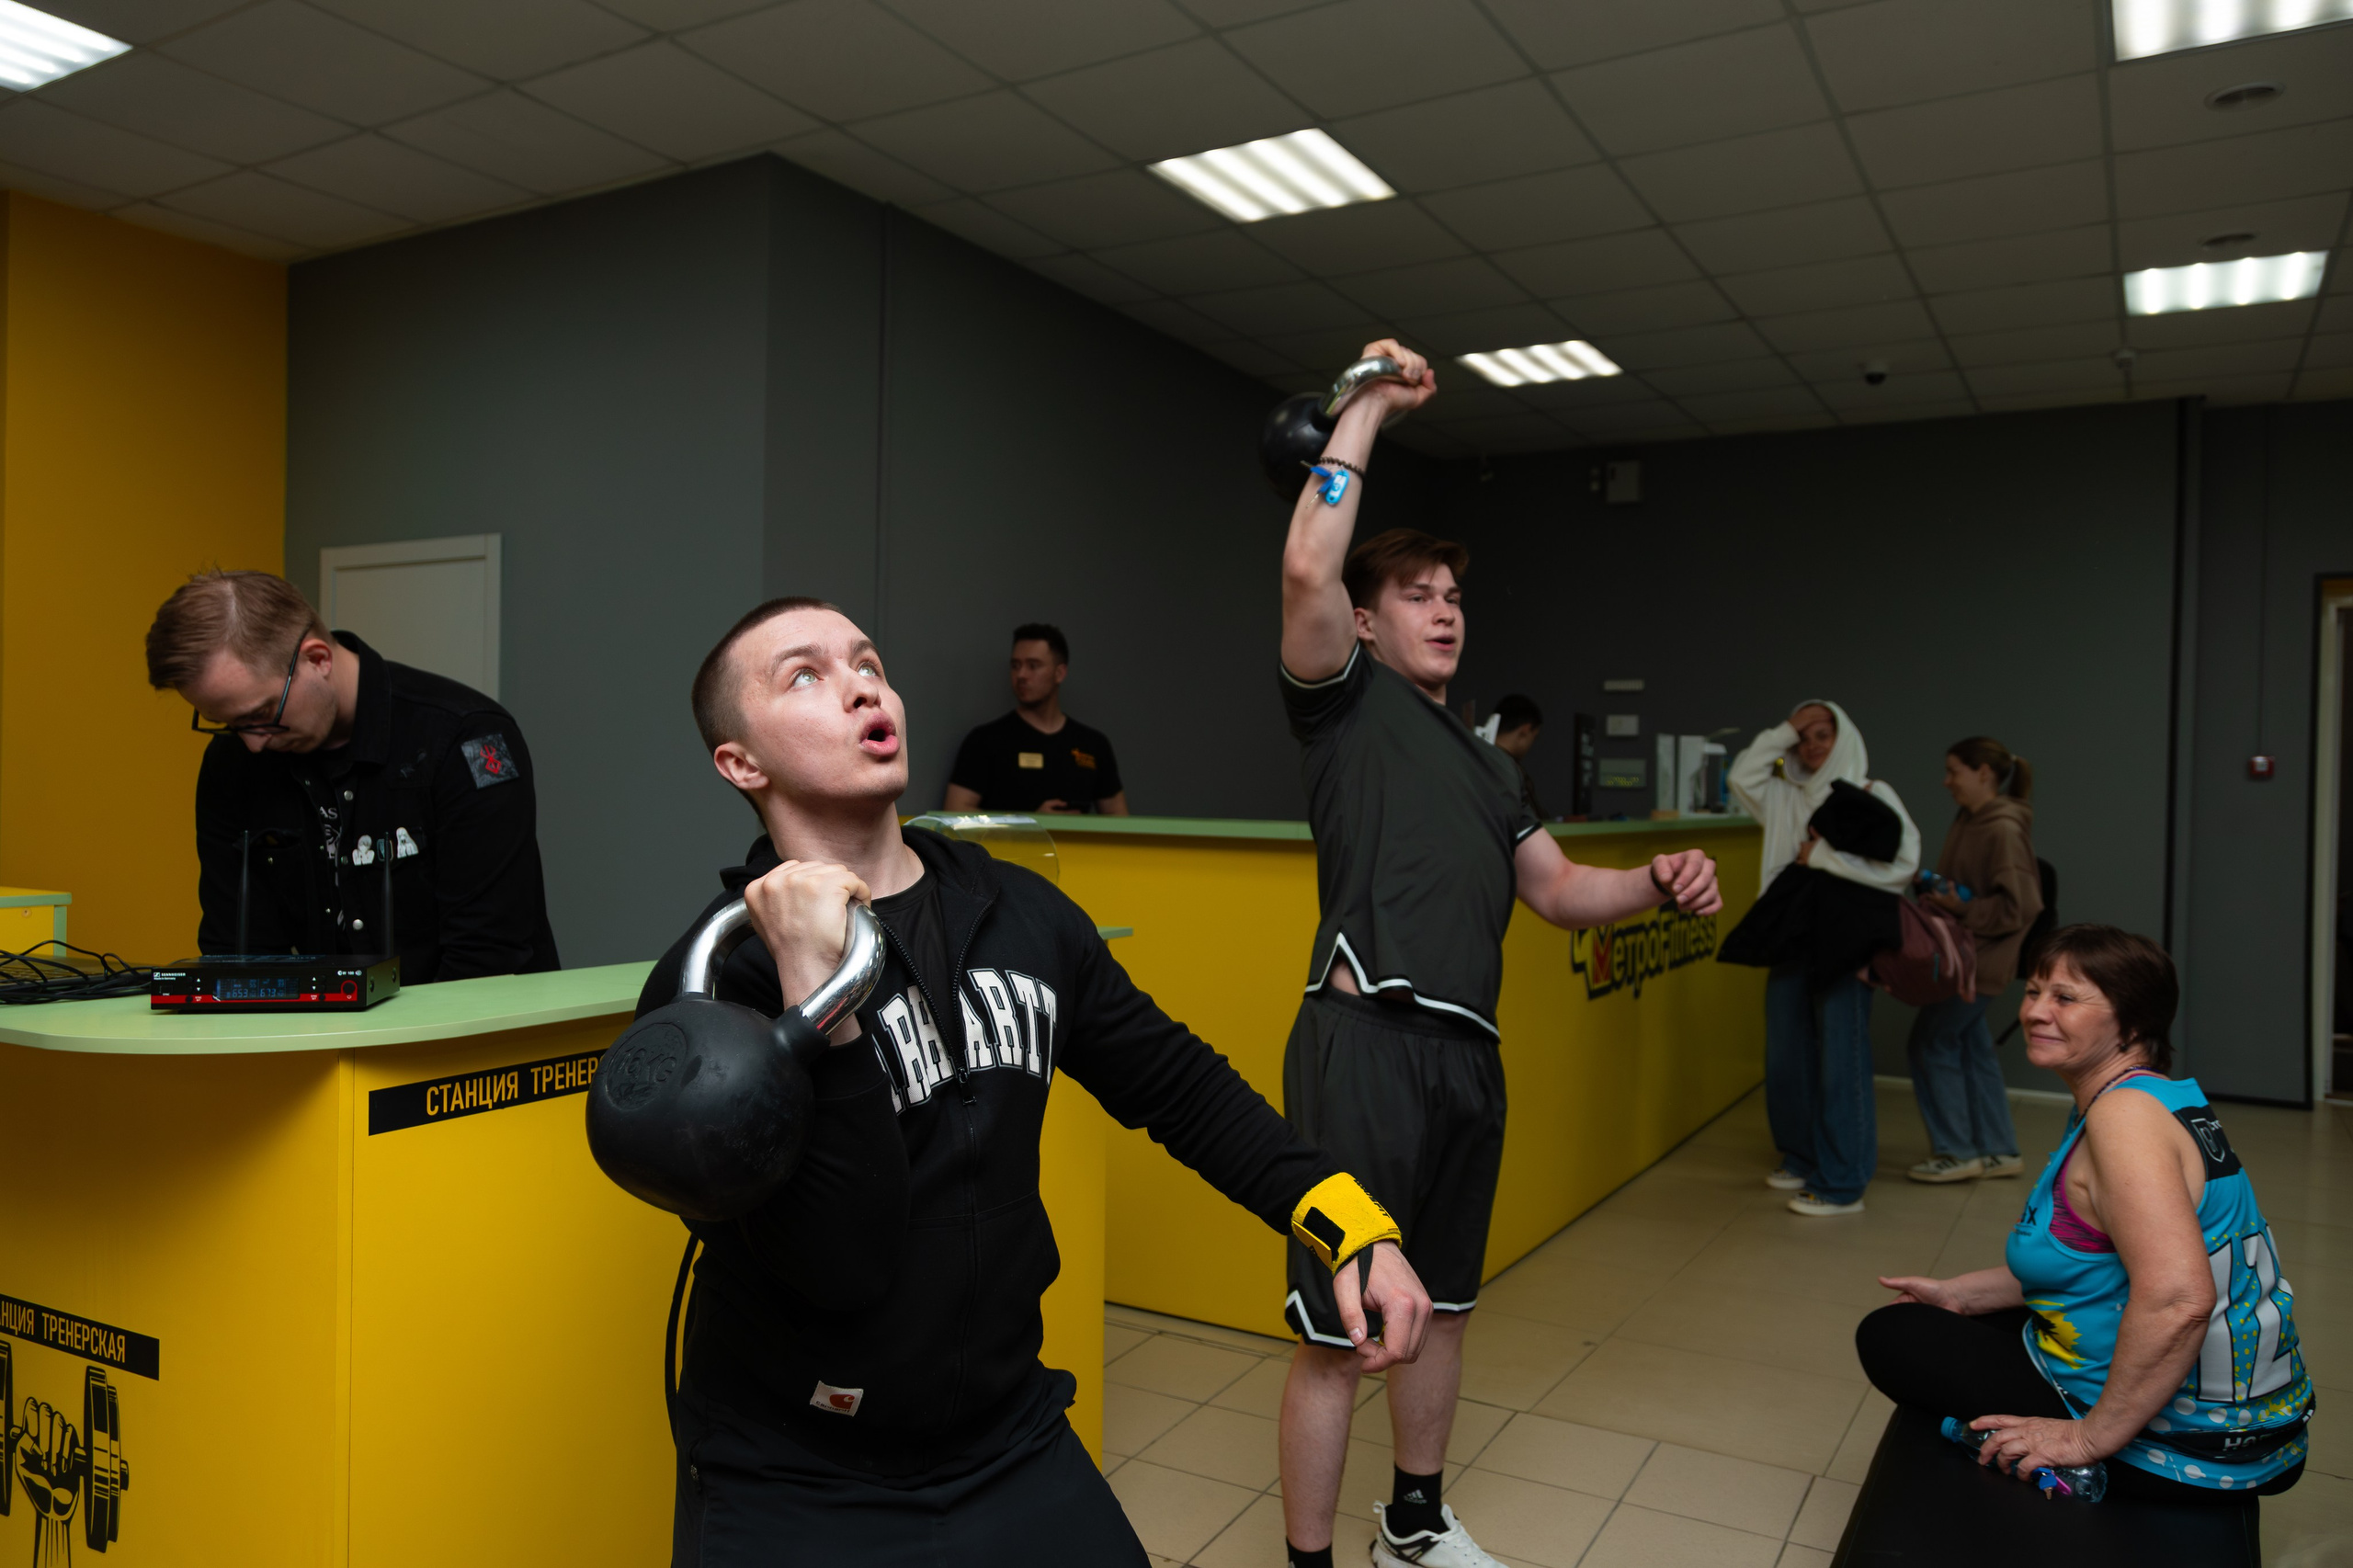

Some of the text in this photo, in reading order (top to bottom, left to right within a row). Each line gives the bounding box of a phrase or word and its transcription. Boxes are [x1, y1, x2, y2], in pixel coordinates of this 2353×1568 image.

[426, 1056, 602, 1116] СТАНЦИЯ ТРЕНЕР
[0, 1301, 126, 1363] НЦИЯ ТРЕНЕРСКАЯ
